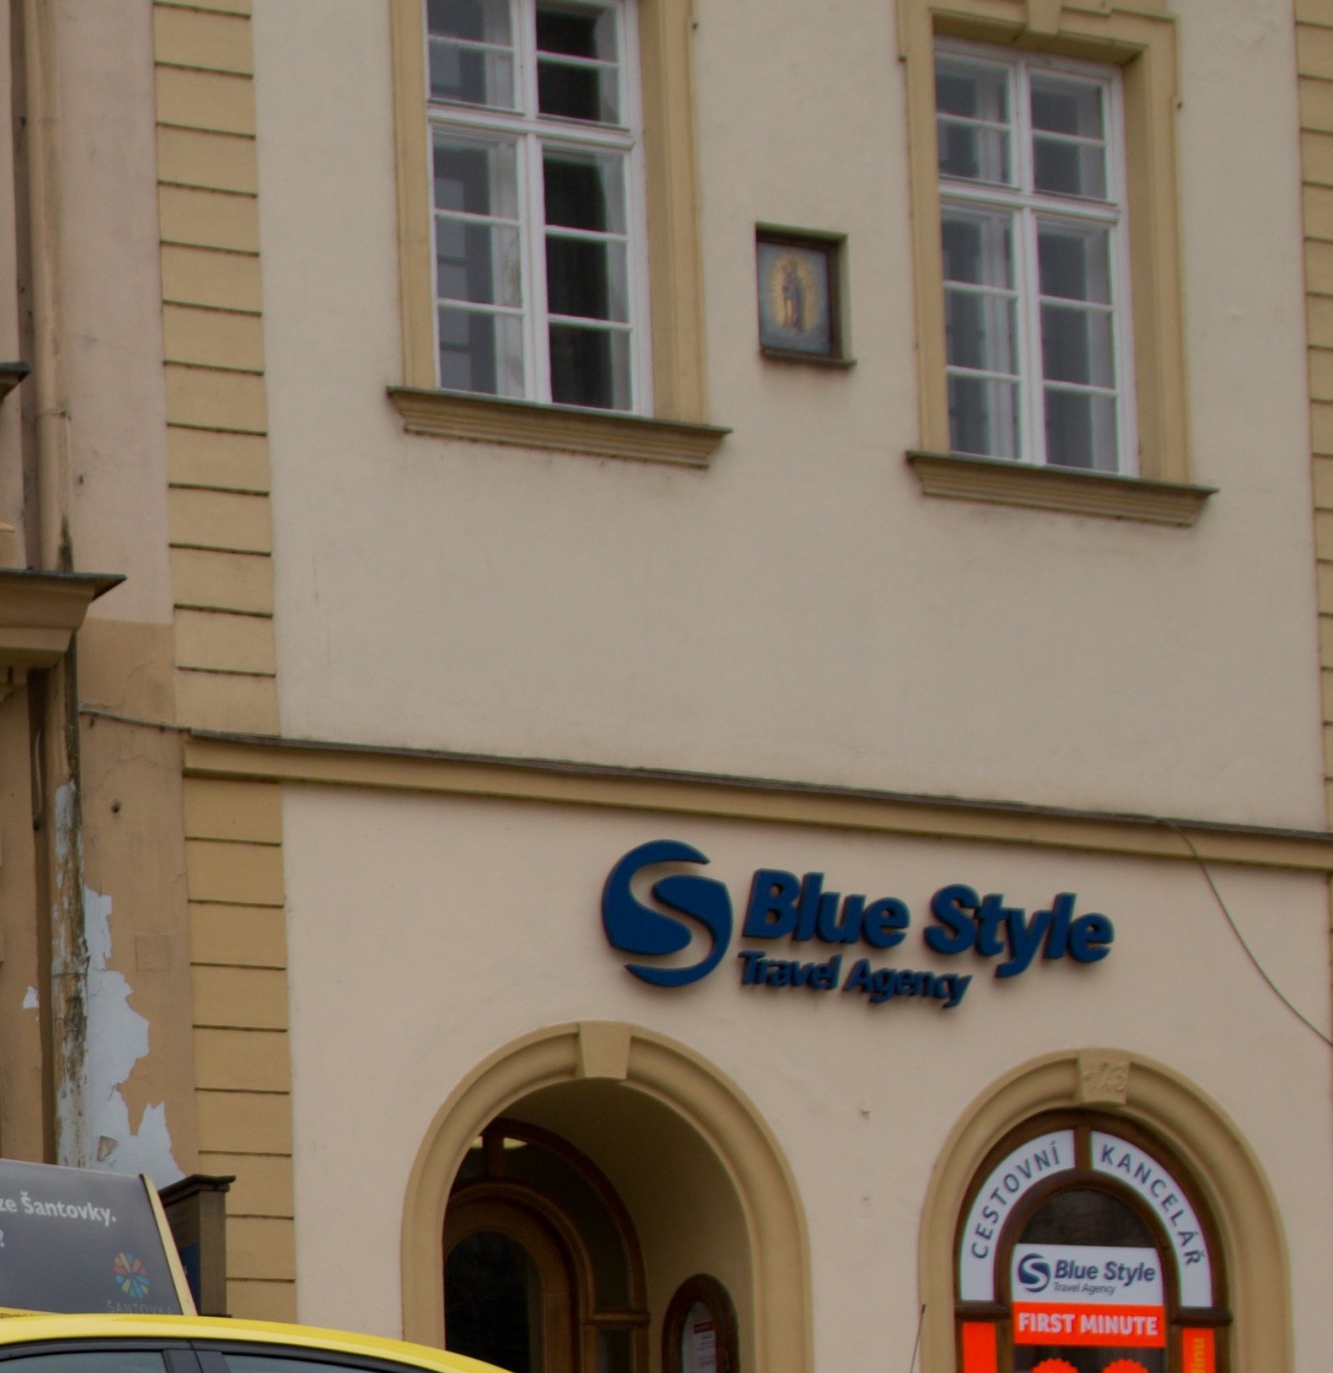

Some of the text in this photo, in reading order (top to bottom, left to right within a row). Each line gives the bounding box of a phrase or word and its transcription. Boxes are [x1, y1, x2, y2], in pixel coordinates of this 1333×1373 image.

[742, 868, 1115, 978] Blue Style
[738, 950, 974, 1009] Travel Agency
[21, 1190, 117, 1227] Šantovky.
[971, 1141, 1205, 1266] CESTOVNÍ KANCELÁŘ
[1053, 1282, 1117, 1295] Travel Agency
[1054, 1260, 1155, 1287] Blue Style
[1019, 1313, 1158, 1337] FIRST MINUTE
